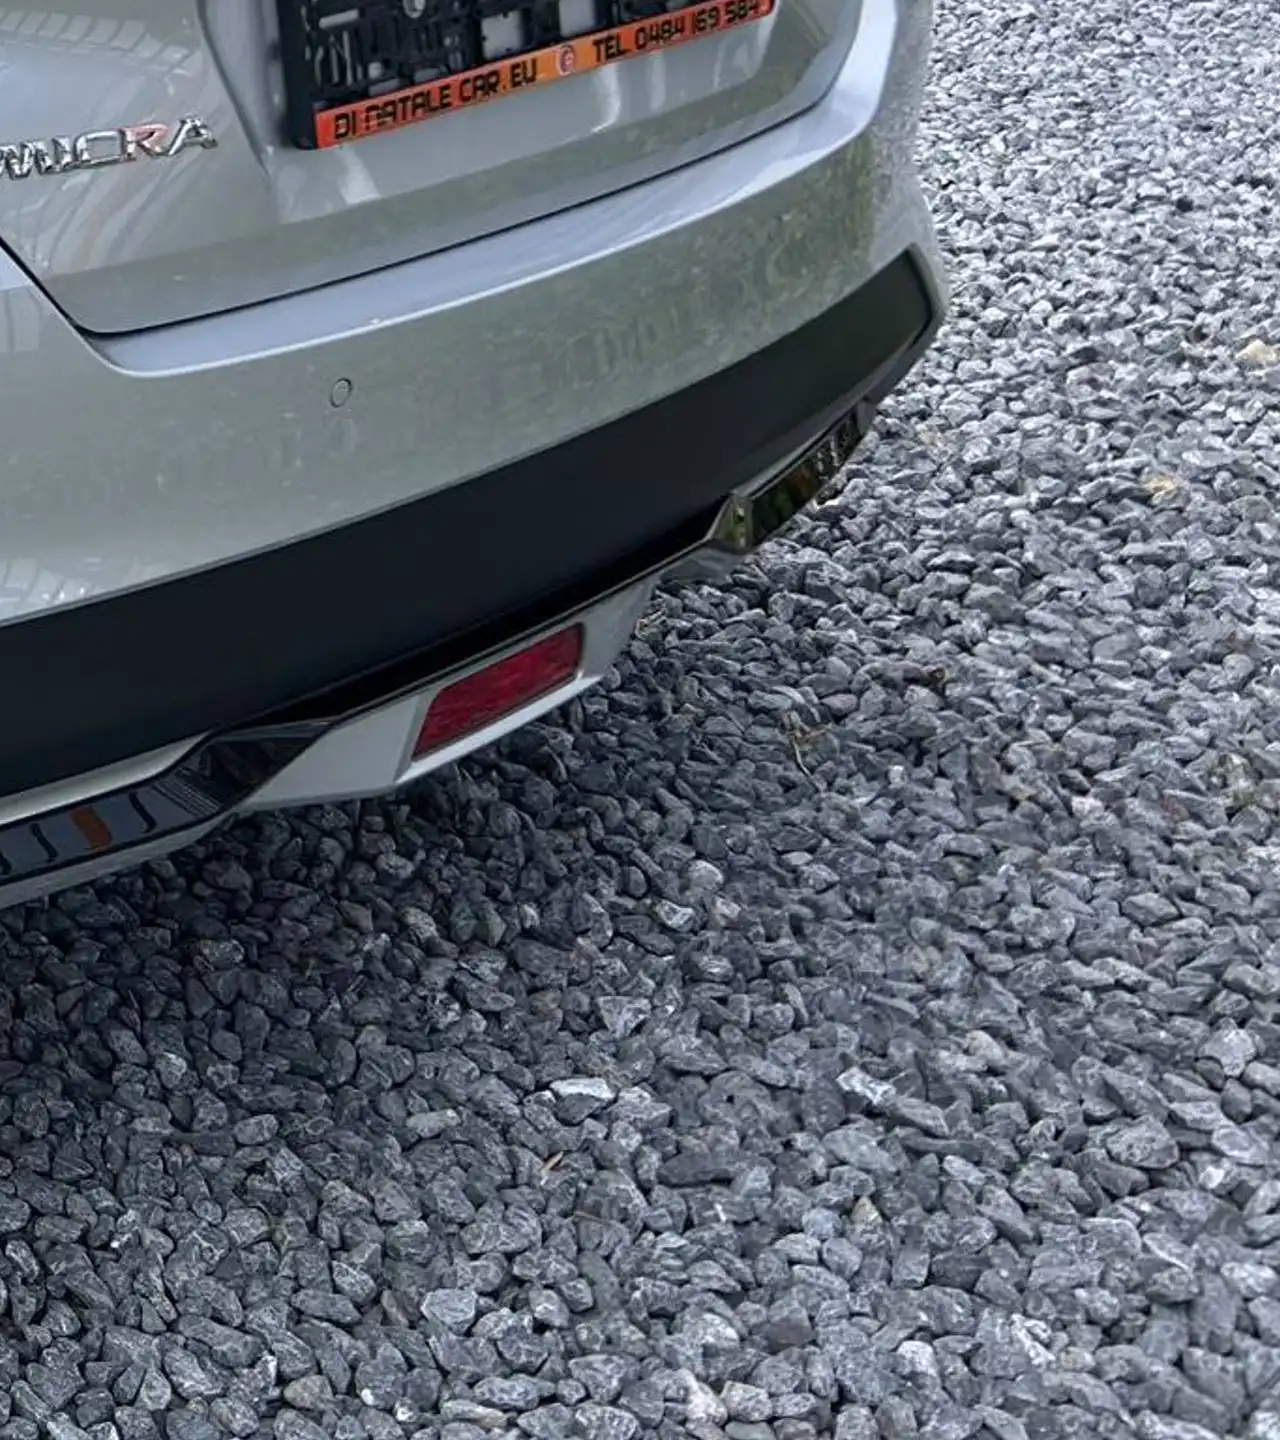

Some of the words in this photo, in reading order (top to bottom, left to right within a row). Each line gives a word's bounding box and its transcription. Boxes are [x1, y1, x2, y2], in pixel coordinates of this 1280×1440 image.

[335, 110, 357, 140] DI
[364, 85, 453, 131] NATALE
[593, 35, 627, 63] TEL
[634, 16, 685, 50] 0484
[690, 5, 719, 35] 169
